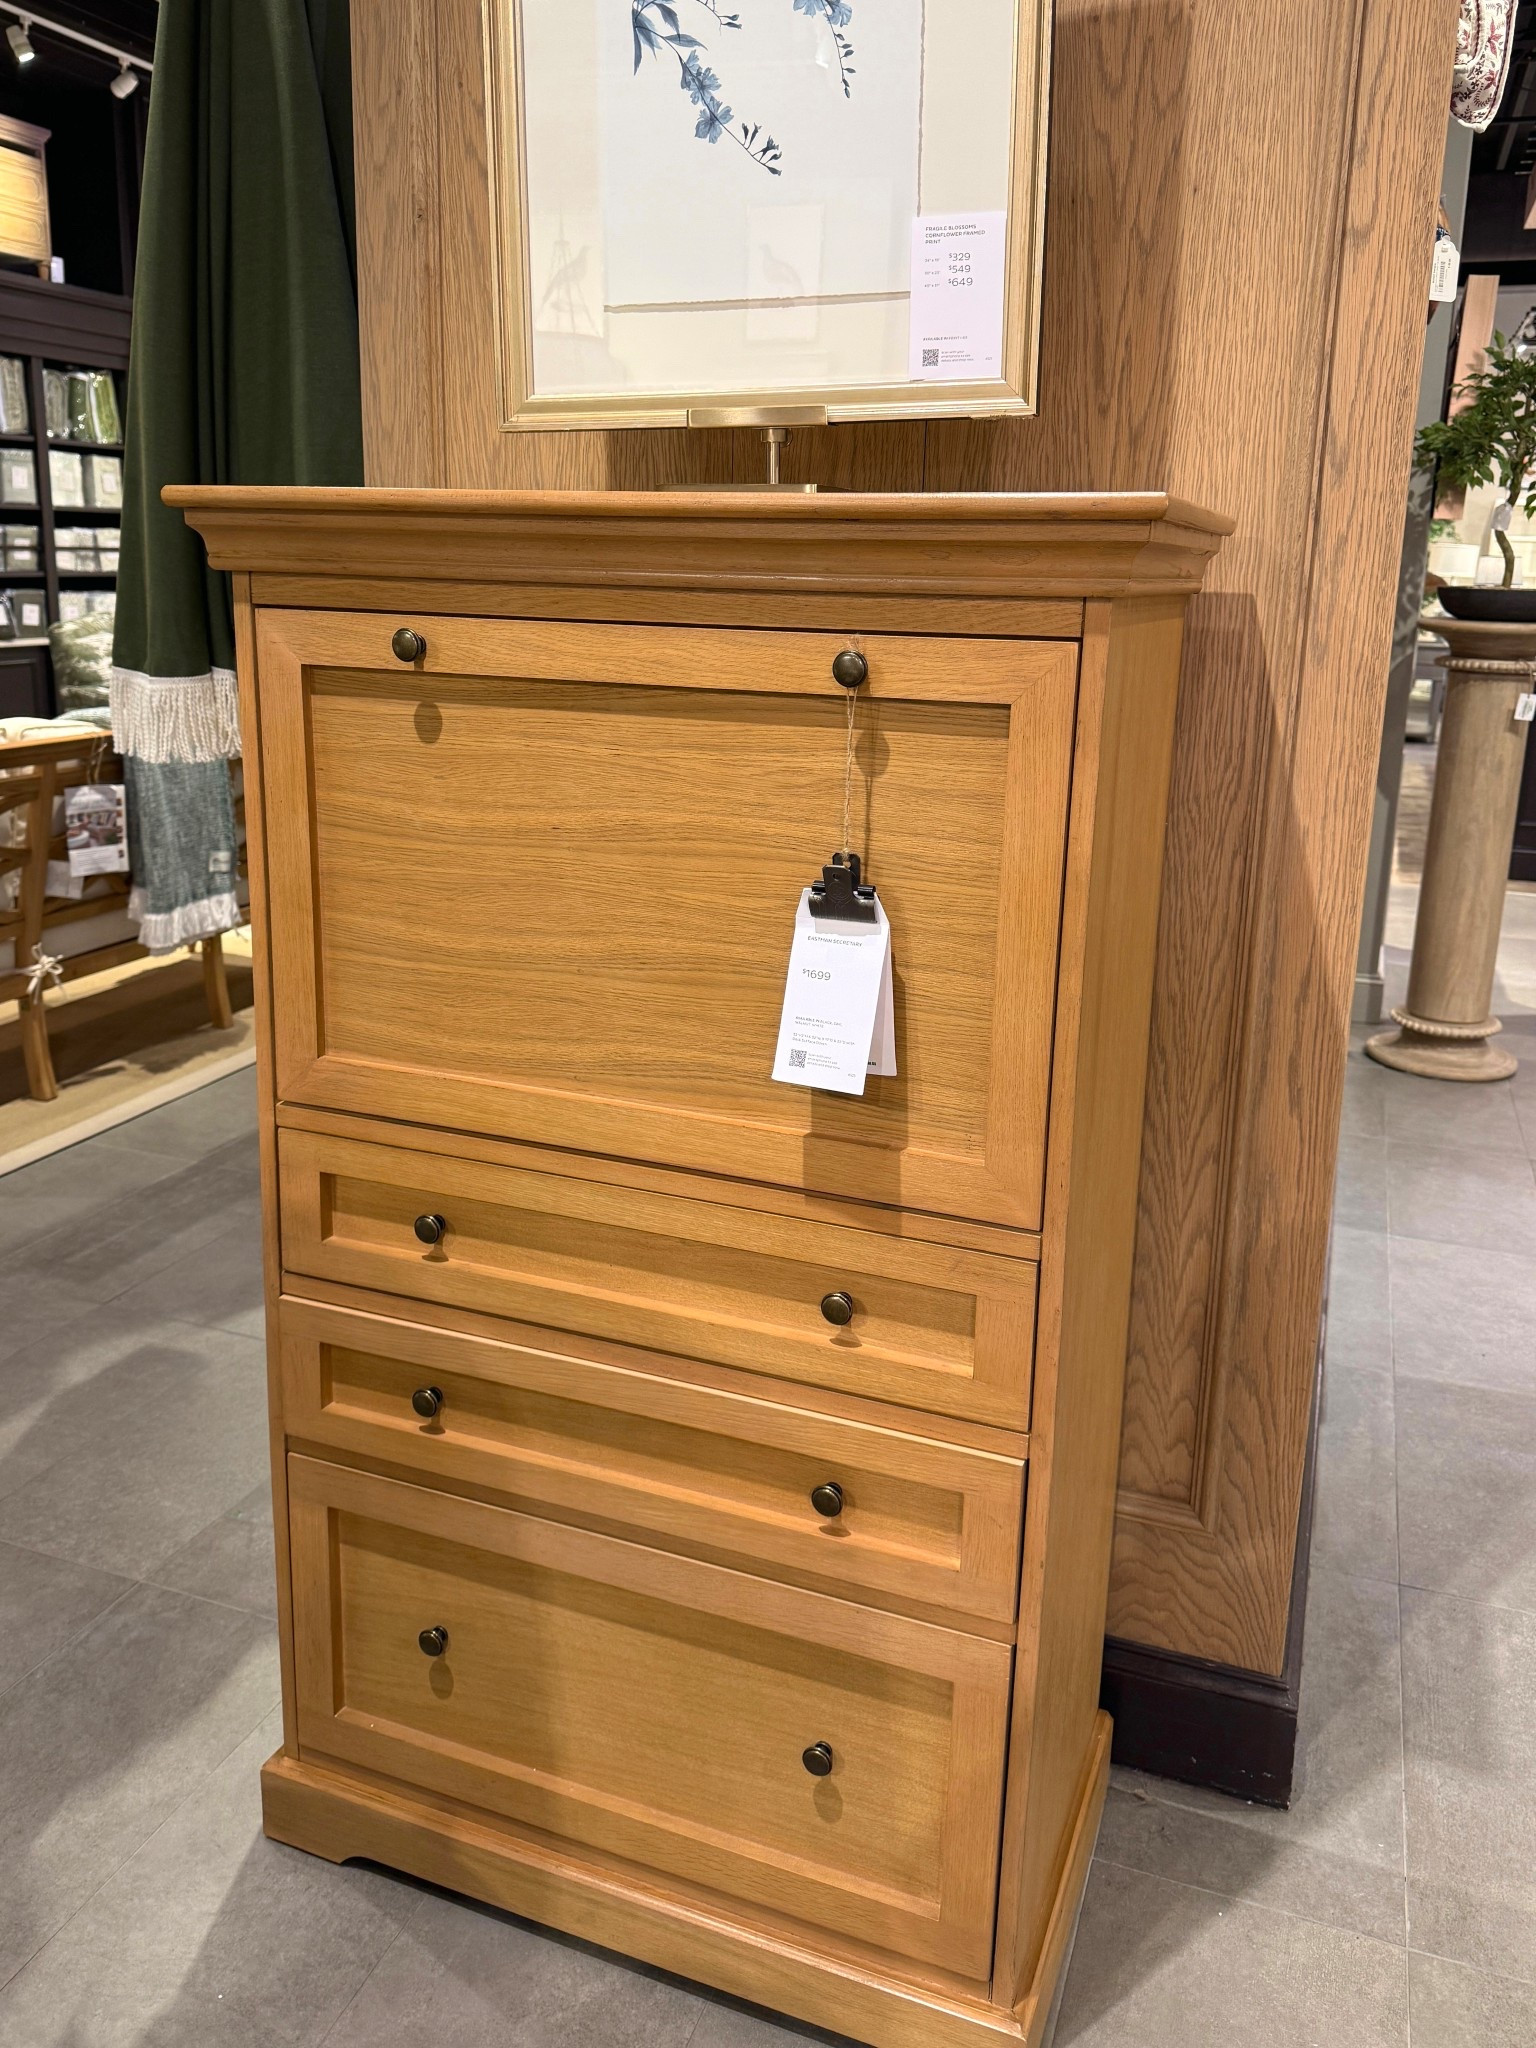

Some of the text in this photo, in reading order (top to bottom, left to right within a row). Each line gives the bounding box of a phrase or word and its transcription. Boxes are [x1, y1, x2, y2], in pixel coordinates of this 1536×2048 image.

[948, 252, 971, 261] $329
[948, 264, 971, 273] $549
[948, 277, 973, 287] $649
[807, 935, 863, 947] EASTMAN SECRETARY
[802, 968, 831, 981] $1699
